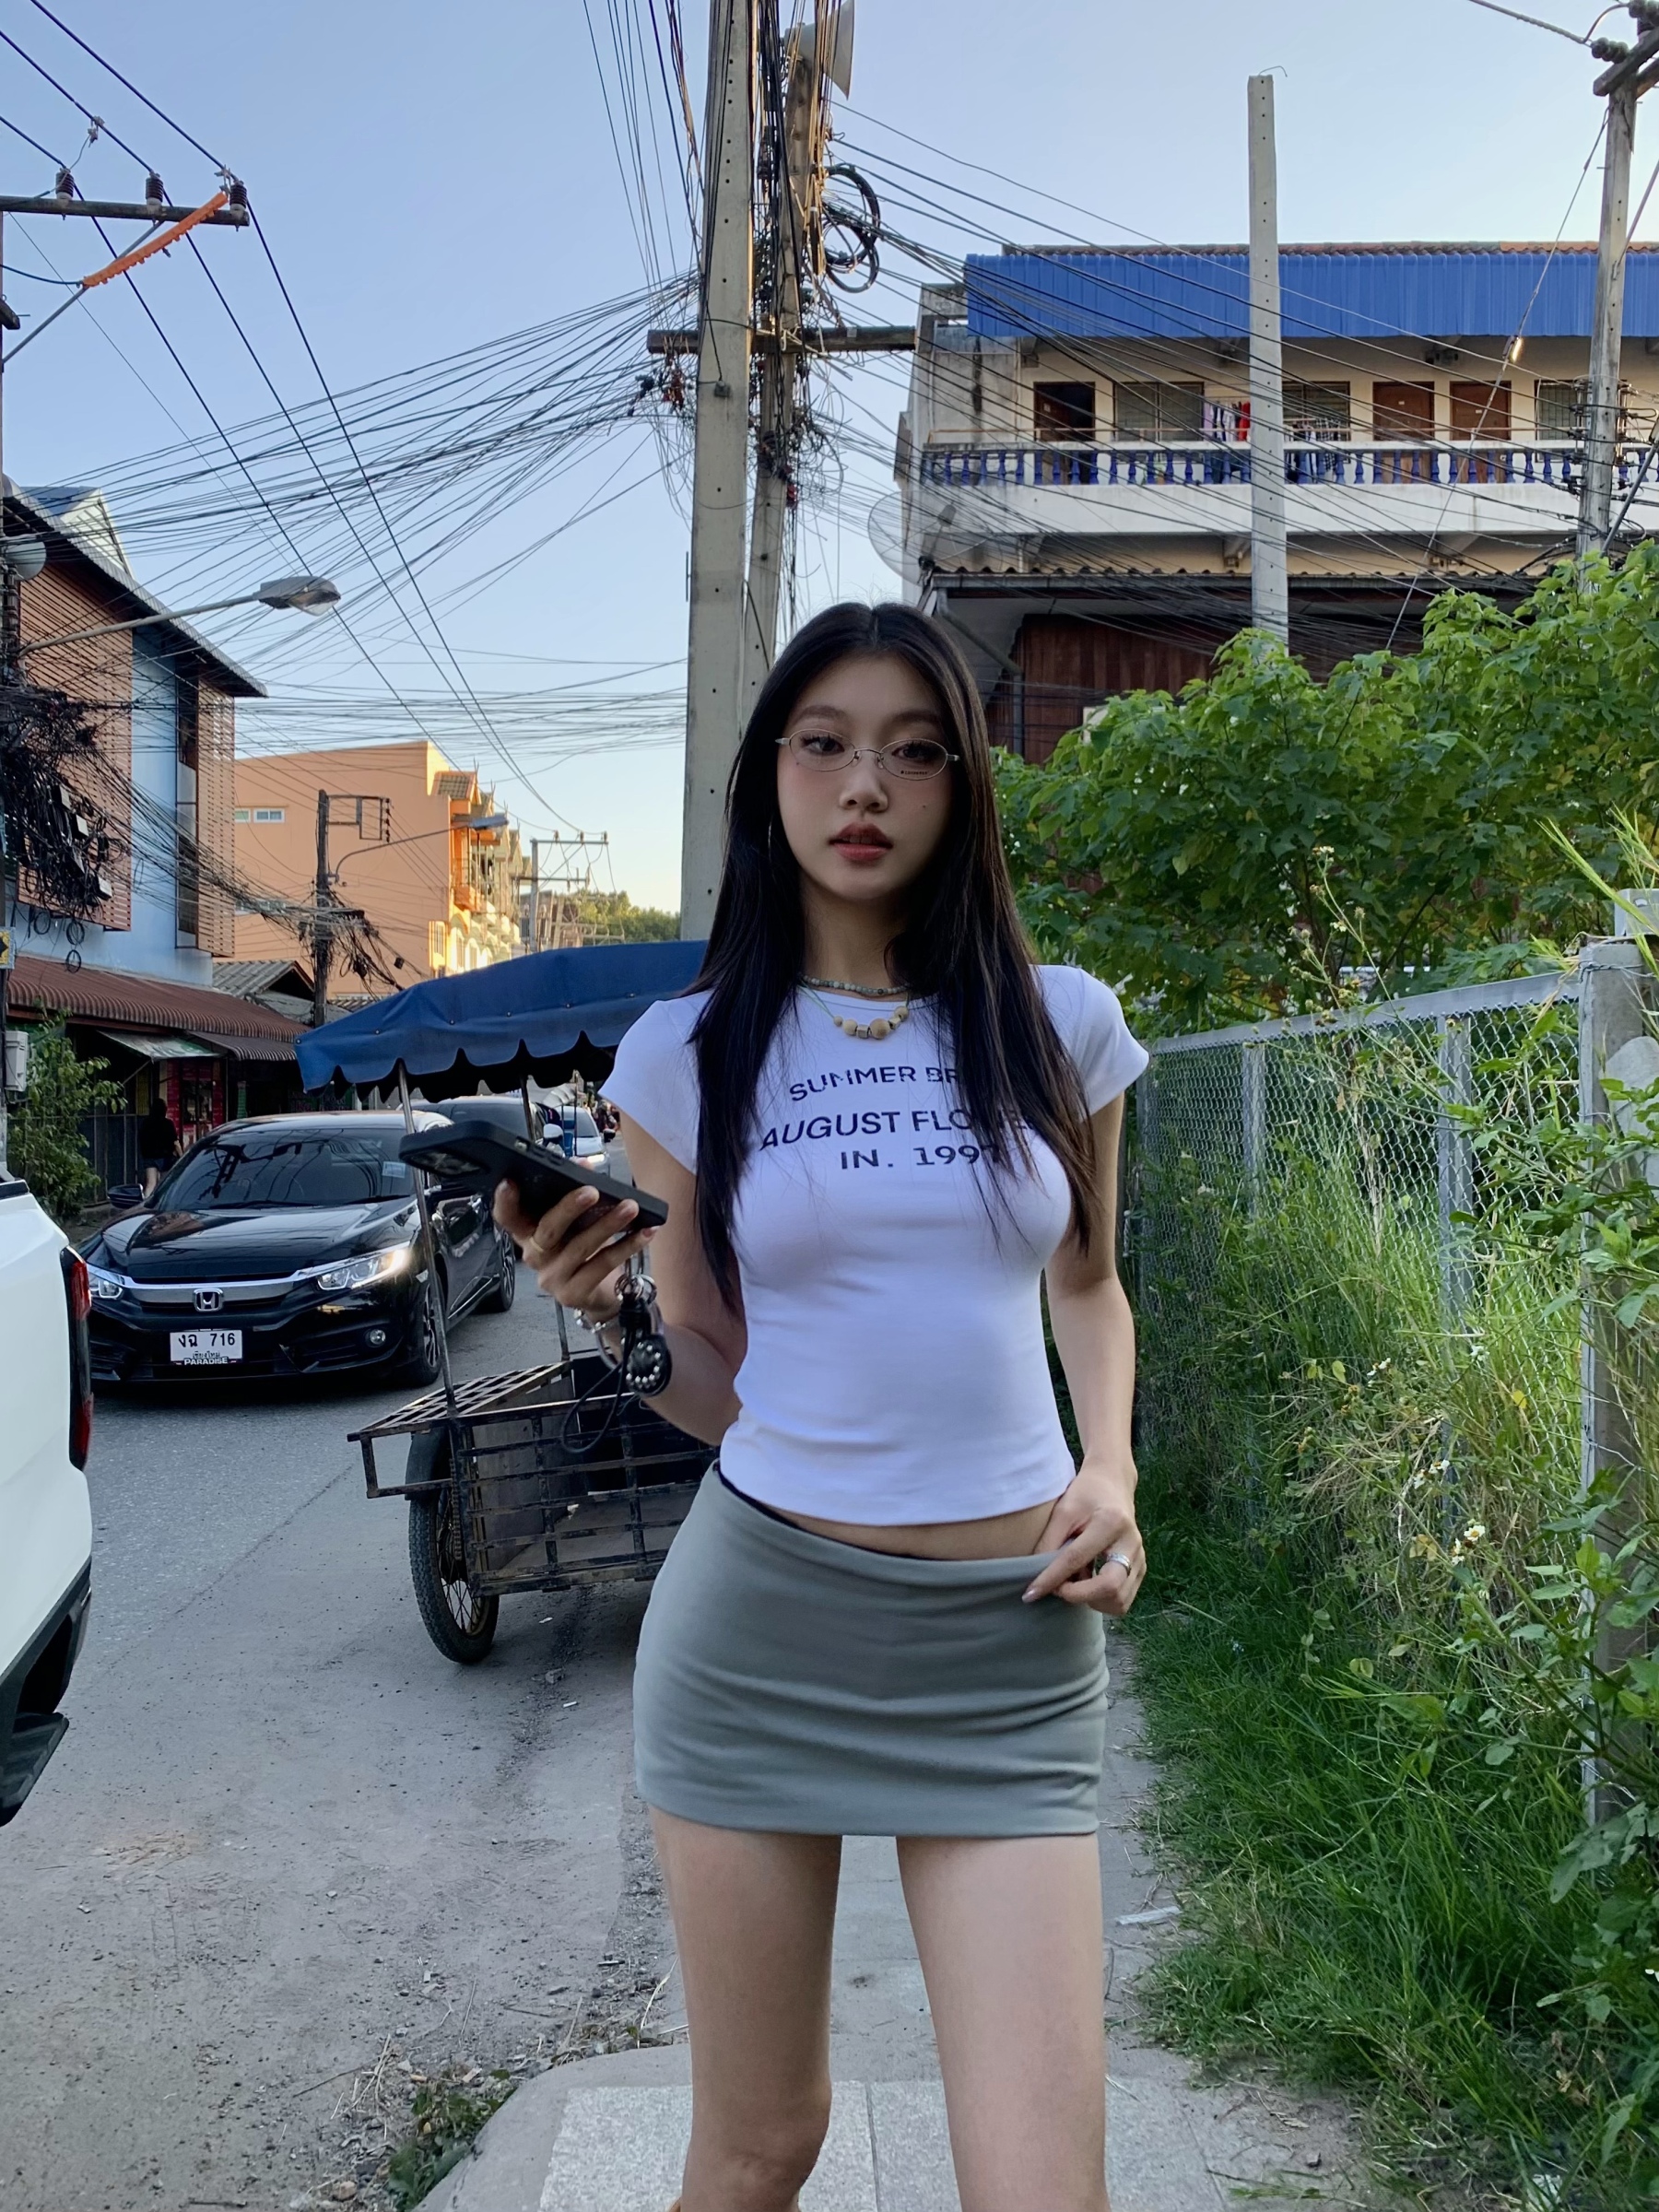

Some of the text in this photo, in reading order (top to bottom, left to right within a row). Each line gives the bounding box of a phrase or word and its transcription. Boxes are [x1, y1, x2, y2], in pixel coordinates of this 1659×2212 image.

[789, 1065, 916, 1101] SUMMER
[759, 1112, 901, 1151] AUGUST
[841, 1148, 894, 1170] IN.
[210, 1333, 235, 1347] 716
[184, 1357, 229, 1365] PARADISE
